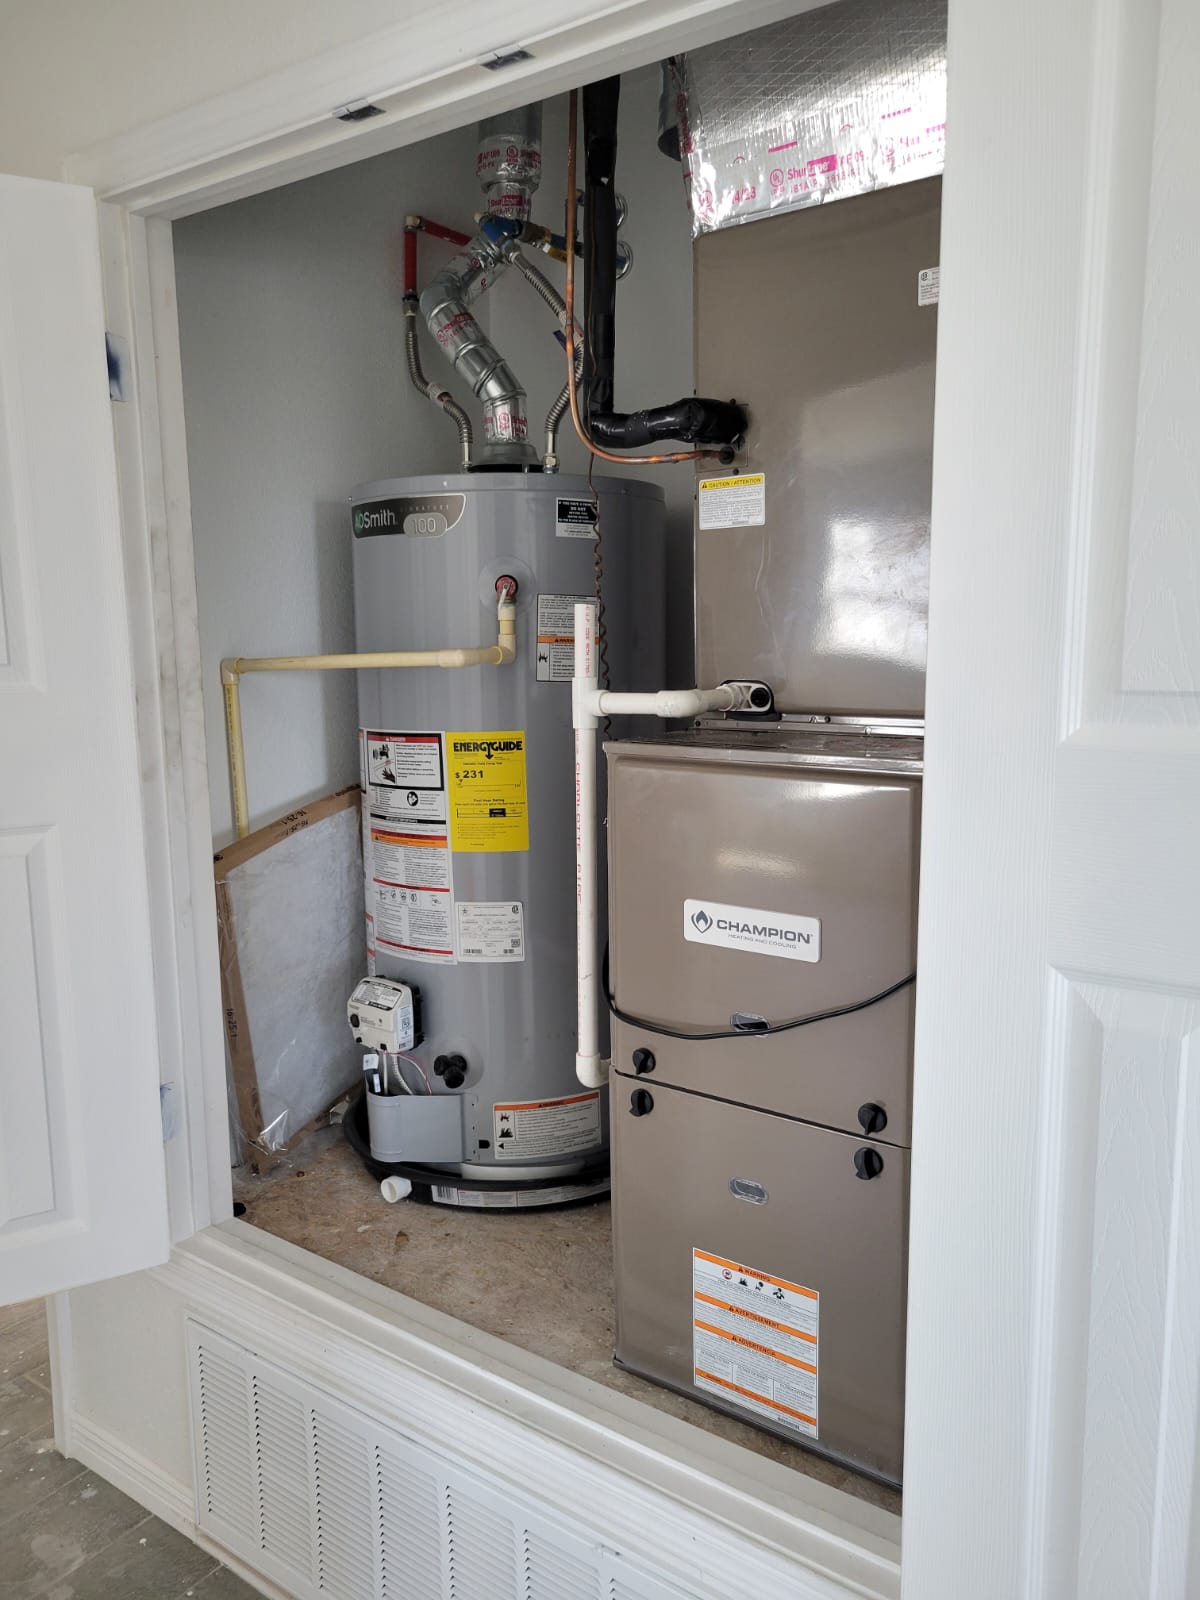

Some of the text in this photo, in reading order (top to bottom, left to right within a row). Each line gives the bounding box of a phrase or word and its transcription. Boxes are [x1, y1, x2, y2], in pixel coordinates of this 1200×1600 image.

[414, 517, 436, 533] 100
[453, 740, 523, 755] ENERGYGUIDE
[463, 770, 484, 779] 231
[716, 919, 811, 945] CHAMPION
[728, 934, 754, 943] HEATING
[768, 940, 798, 950] COOLING
[744, 1269, 771, 1282] WARNING
[734, 1305, 780, 1330] AVERTISSEMENT
